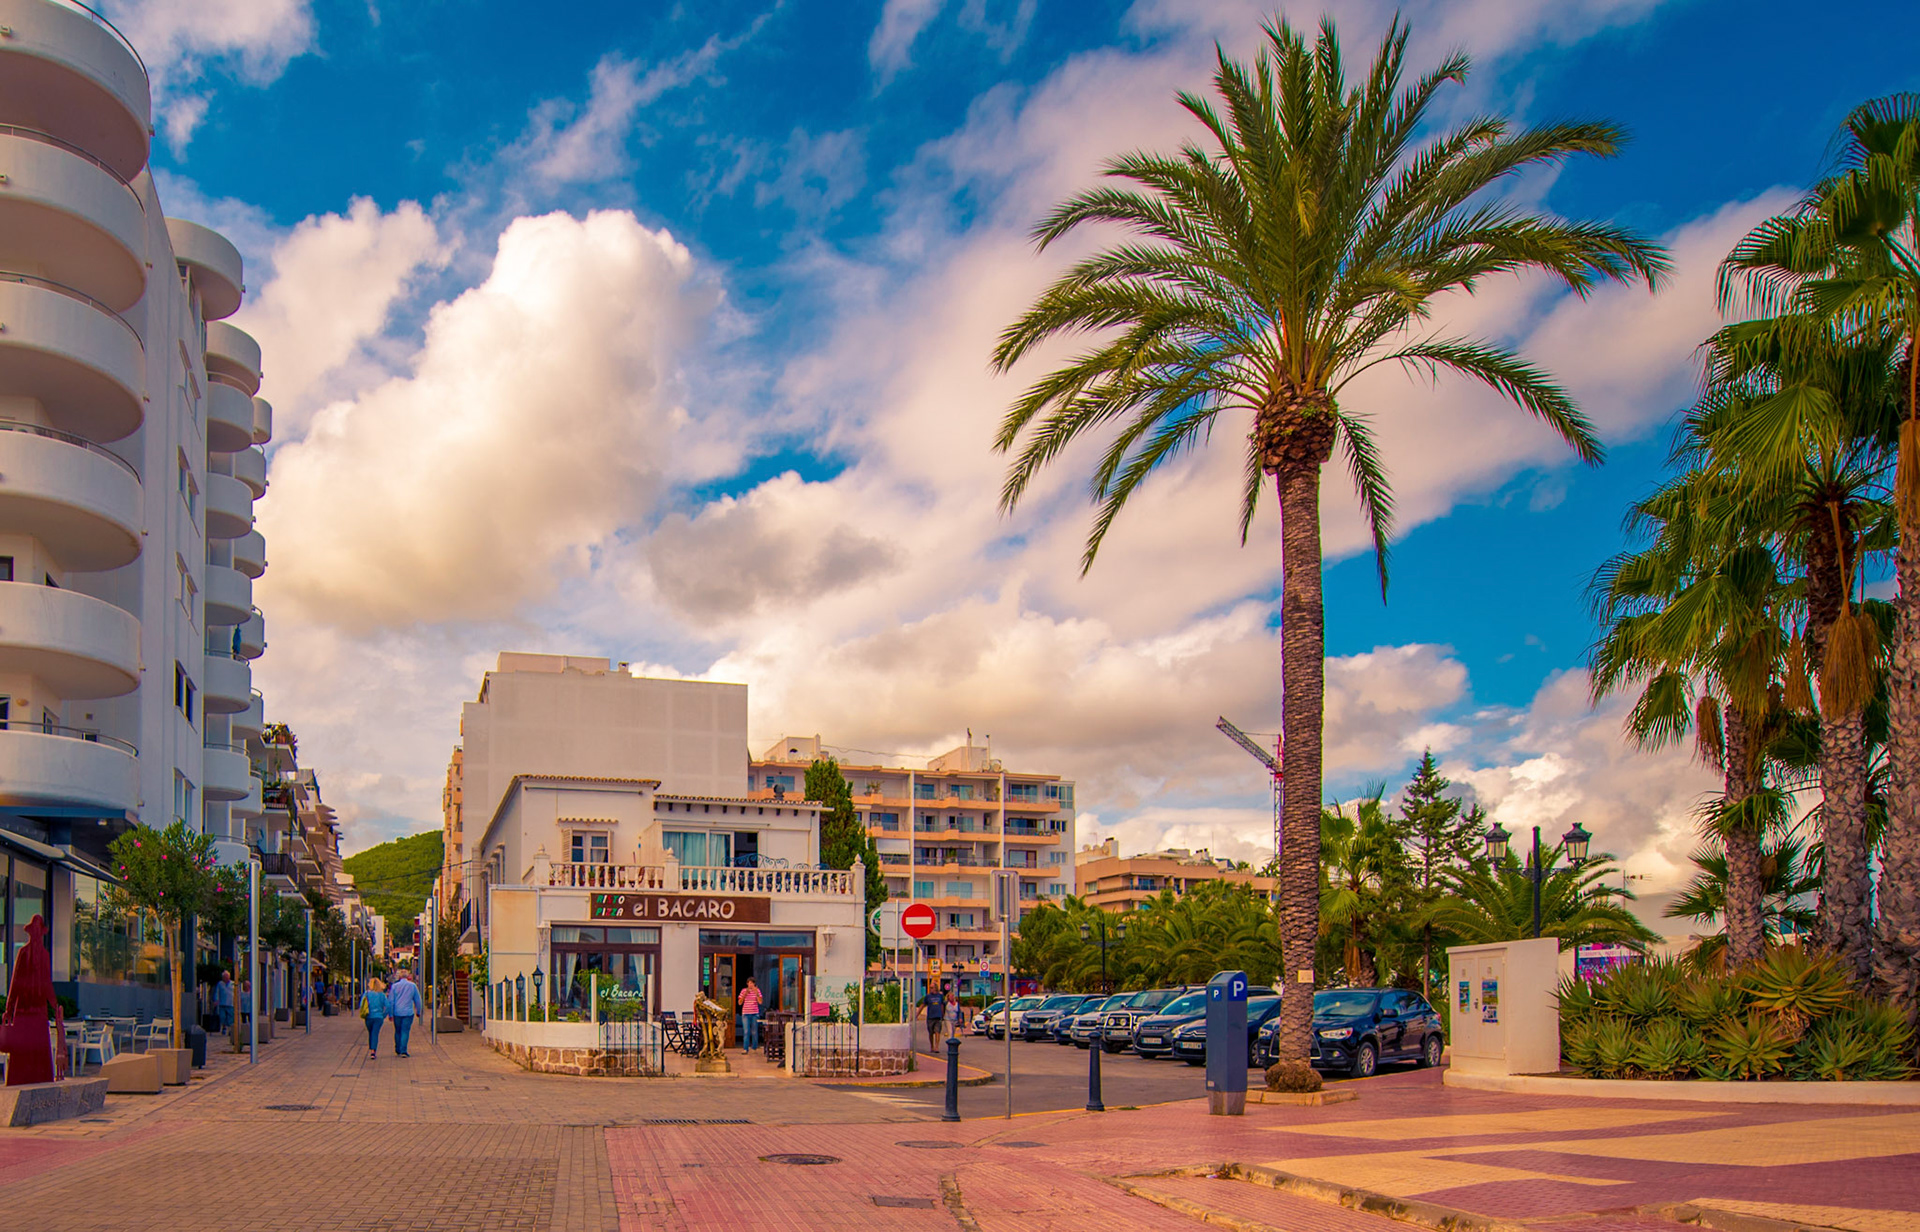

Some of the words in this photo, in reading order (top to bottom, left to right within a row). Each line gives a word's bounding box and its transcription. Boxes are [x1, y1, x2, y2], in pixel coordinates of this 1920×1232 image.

[596, 895, 625, 904] RISTO
[595, 907, 624, 916] PIZZA
[633, 898, 649, 917] el
[657, 898, 735, 919] BACARO
[600, 988, 610, 998] el
[1233, 980, 1244, 997] P
[1213, 989, 1220, 998] P
